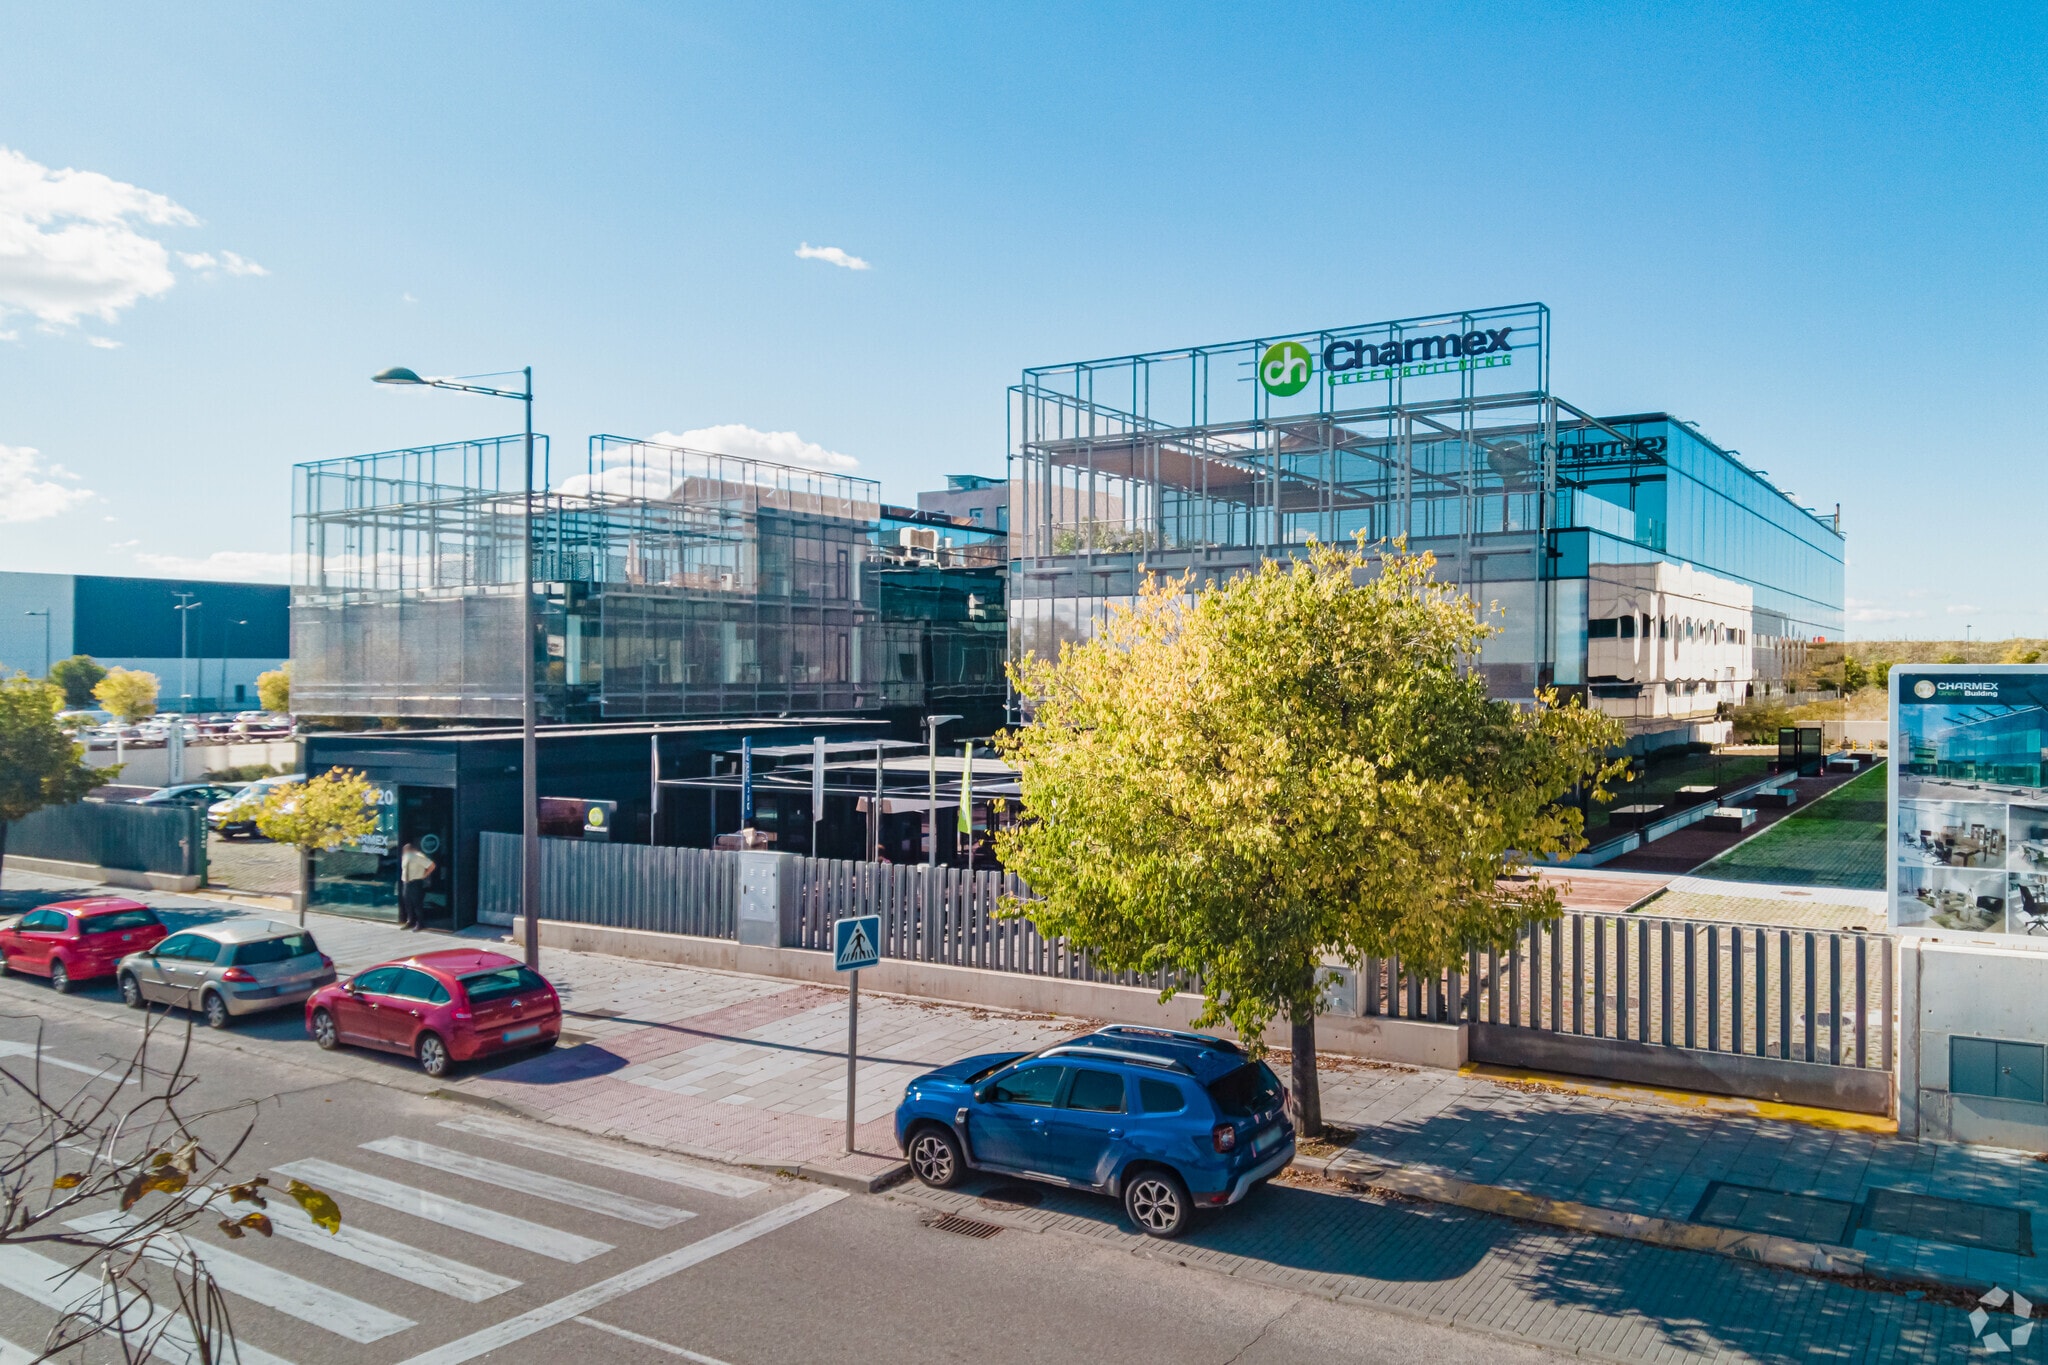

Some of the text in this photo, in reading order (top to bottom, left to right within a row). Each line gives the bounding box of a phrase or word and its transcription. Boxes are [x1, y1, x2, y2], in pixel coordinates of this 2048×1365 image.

[1324, 327, 1512, 371] Charmex
[1936, 682, 1999, 690] CHARMEX
[1964, 690, 1998, 698] Building
